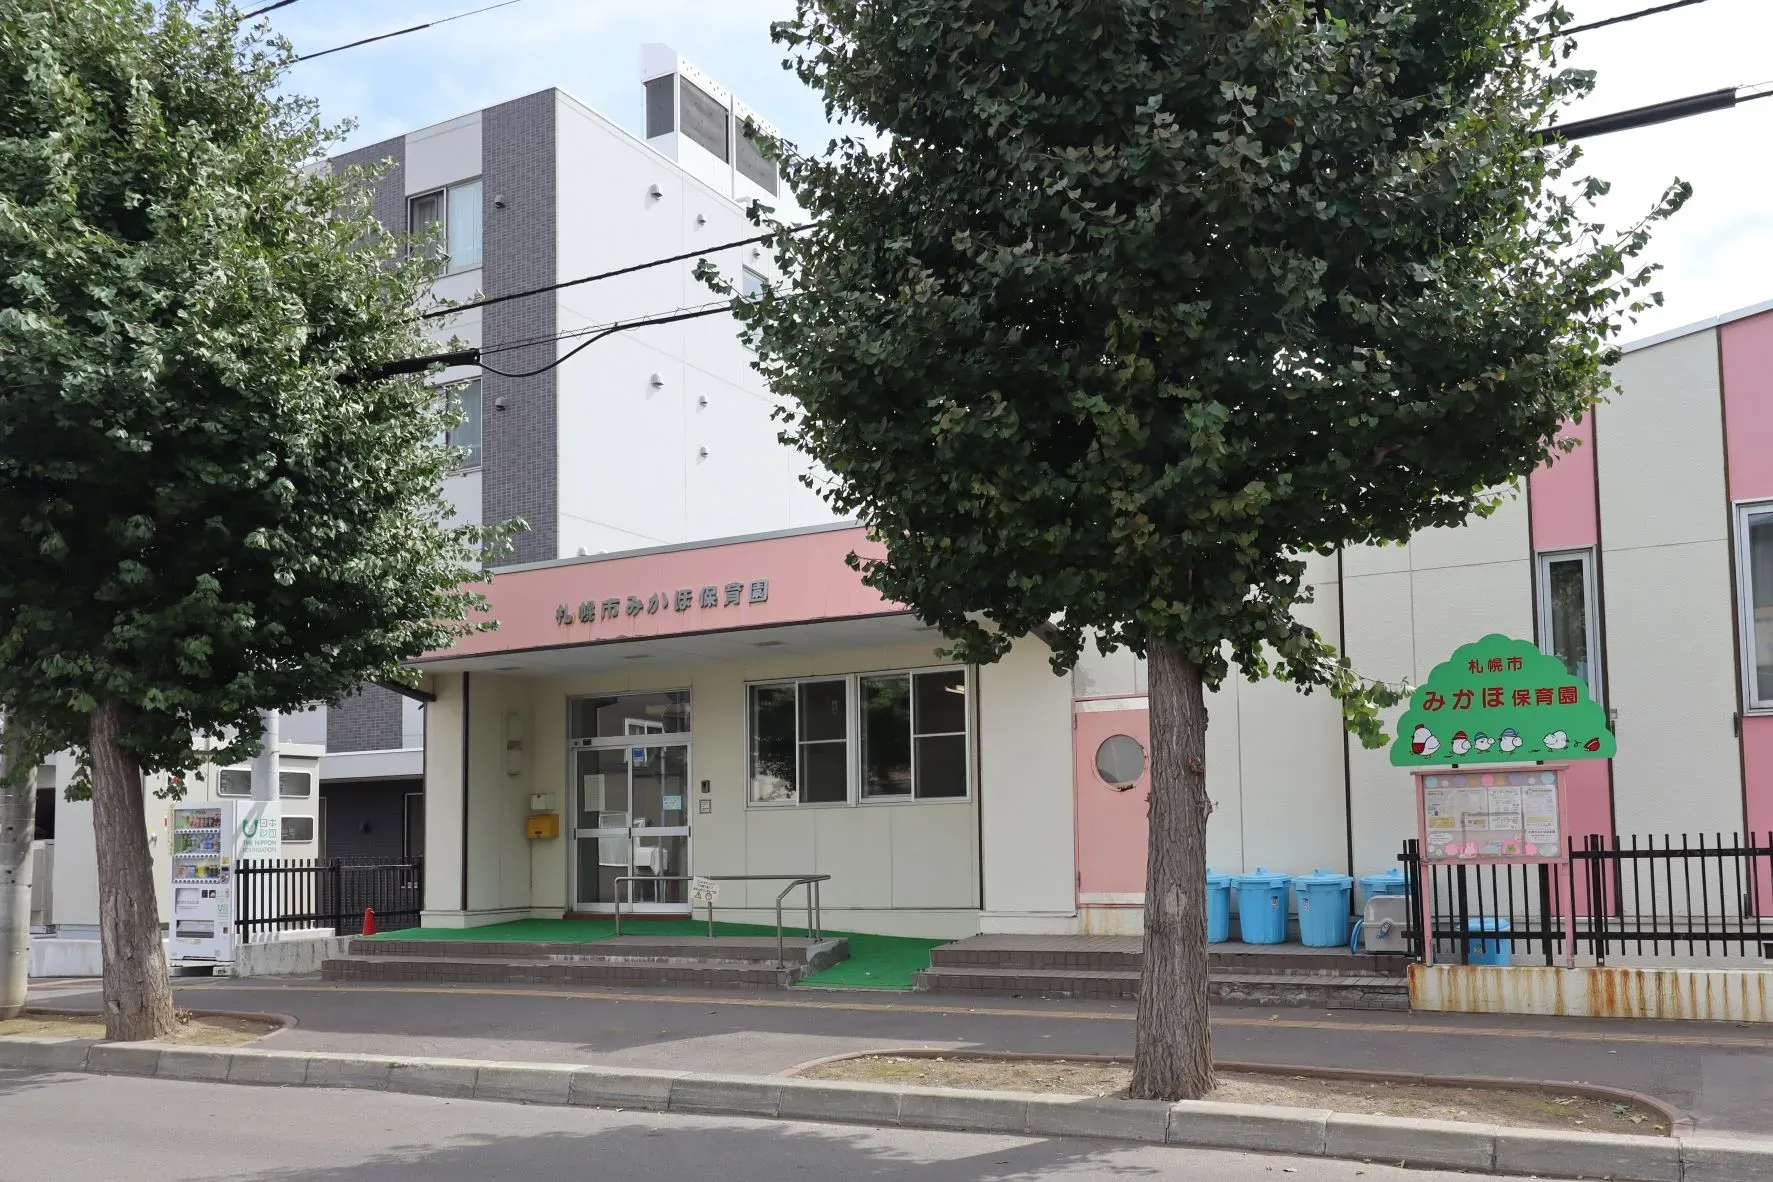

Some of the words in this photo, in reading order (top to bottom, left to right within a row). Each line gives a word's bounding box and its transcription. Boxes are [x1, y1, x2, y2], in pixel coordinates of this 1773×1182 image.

[555, 579, 769, 625] 札幌市みかほ保育園
[1468, 656, 1523, 674] 札幌市
[1422, 685, 1578, 711] みかほ保育園
